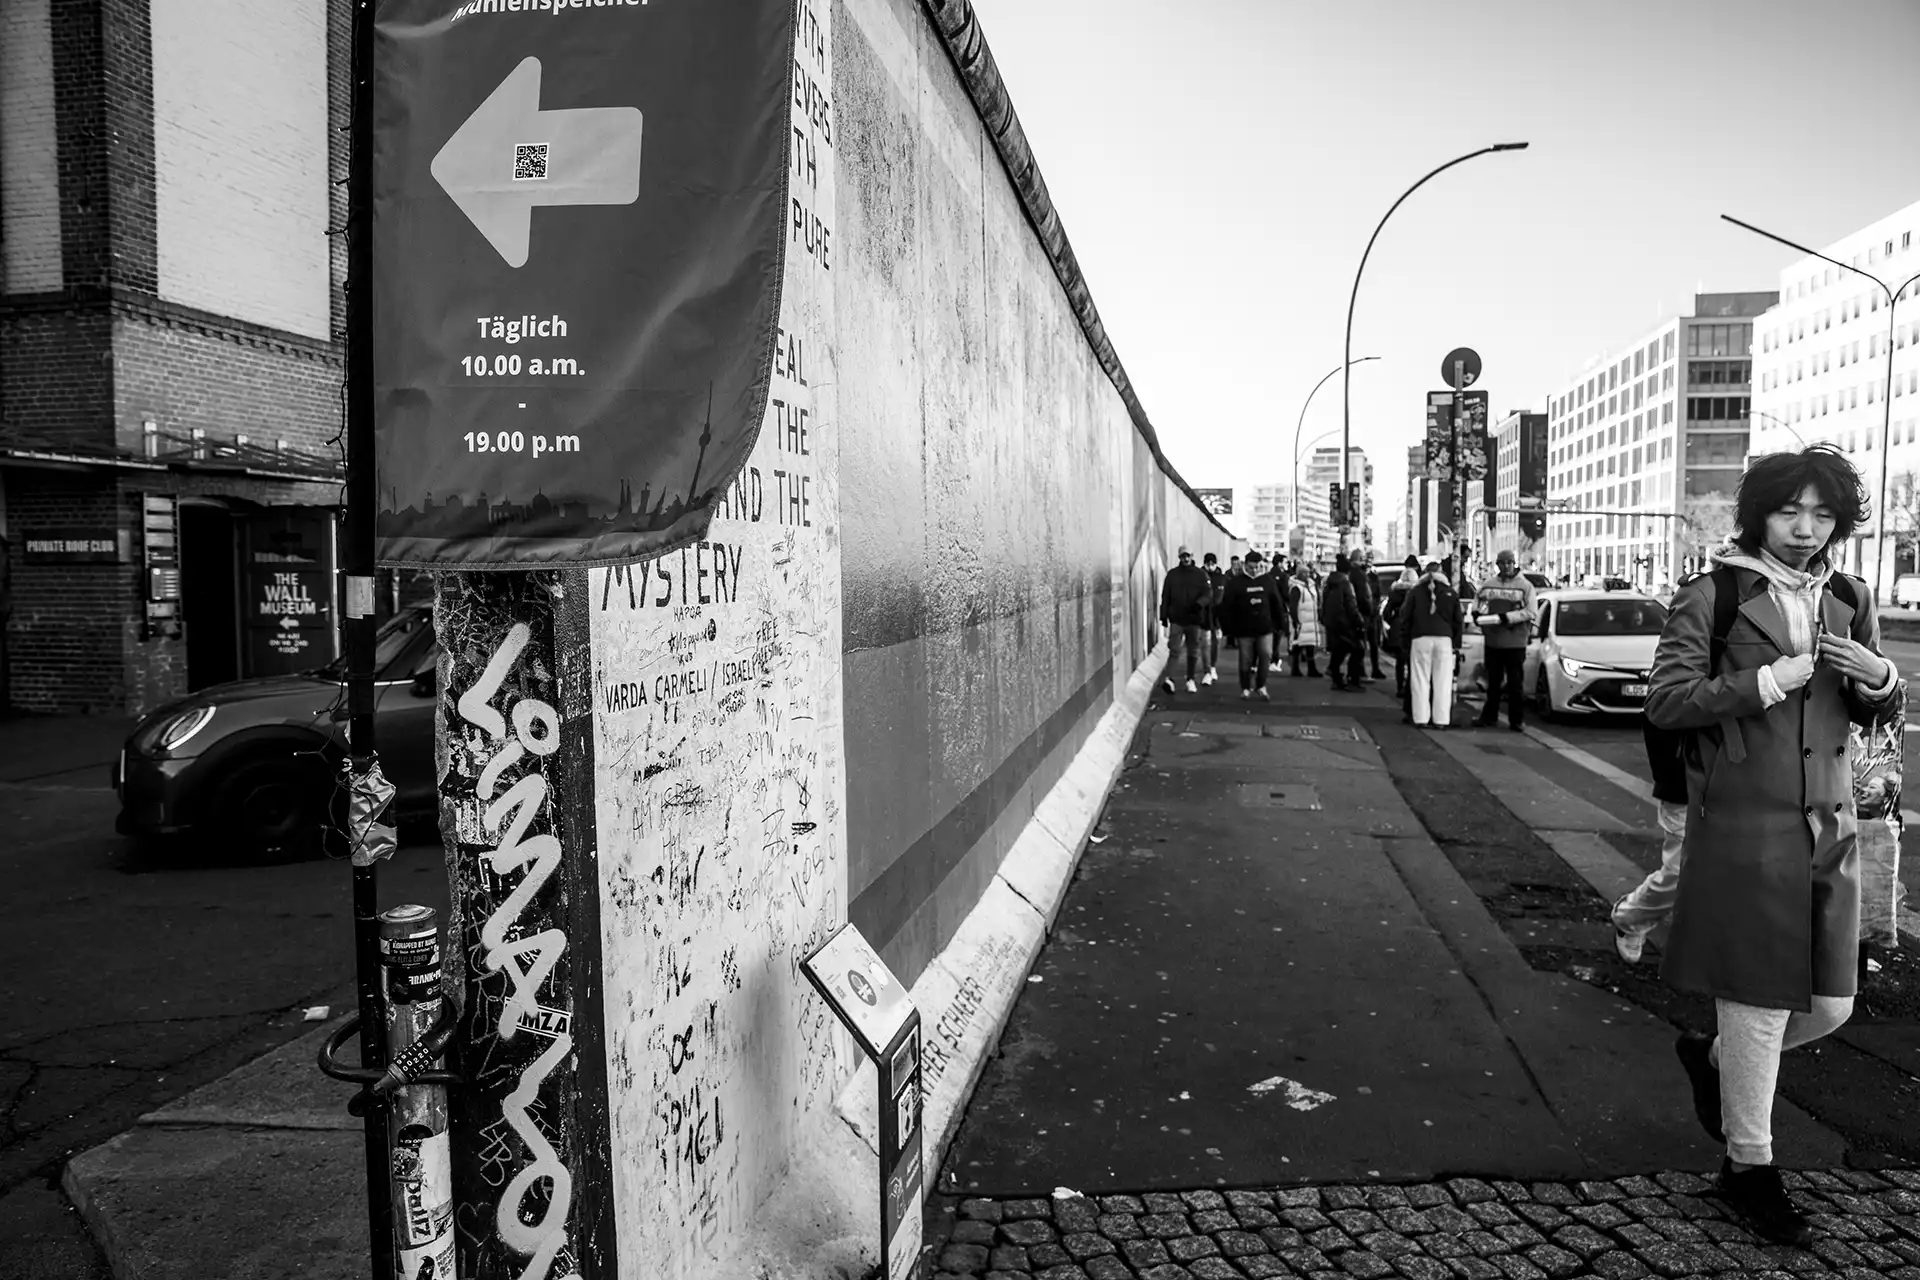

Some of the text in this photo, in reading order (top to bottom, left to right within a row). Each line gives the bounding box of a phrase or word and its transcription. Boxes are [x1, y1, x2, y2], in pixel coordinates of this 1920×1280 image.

[789, 126, 816, 189] TH
[793, 198, 830, 270] PURE
[477, 315, 567, 344] Täglich
[461, 354, 586, 377] 10.00 a.m.
[464, 431, 580, 459] 19.00 p.m
[772, 398, 809, 456] THE
[774, 469, 811, 528] THE
[264, 585, 312, 601] WALL
[274, 573, 299, 585] THE
[602, 541, 742, 611] MYSTERY
[260, 602, 316, 615] MUSEUM
[606, 681, 648, 713] VARDA
[655, 668, 707, 702] CARMELI
[722, 660, 753, 687] ISRAEL
